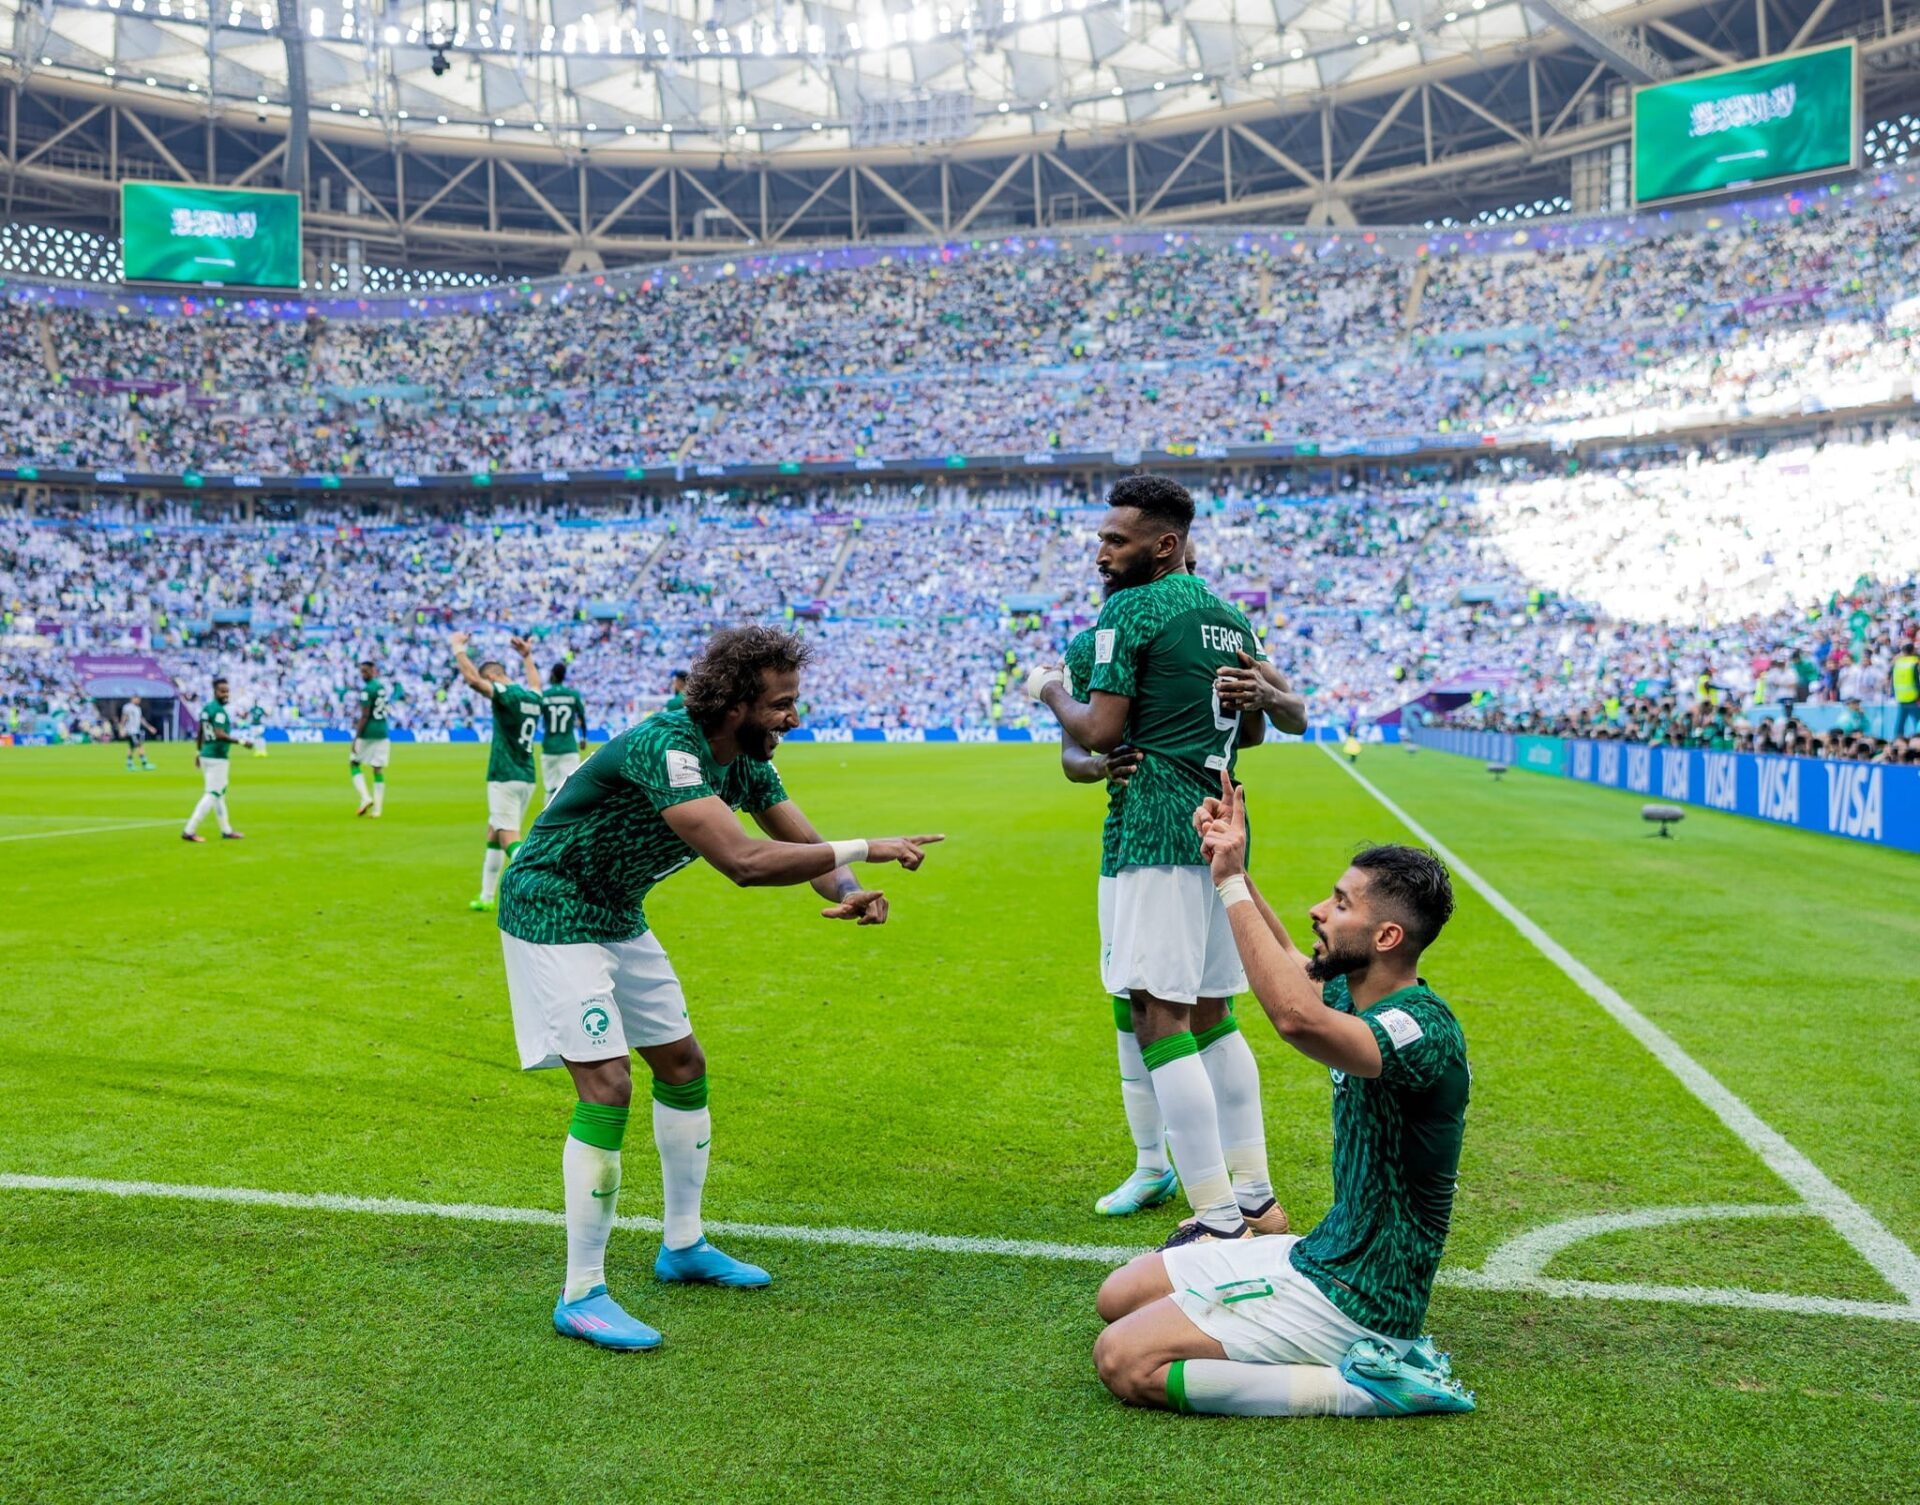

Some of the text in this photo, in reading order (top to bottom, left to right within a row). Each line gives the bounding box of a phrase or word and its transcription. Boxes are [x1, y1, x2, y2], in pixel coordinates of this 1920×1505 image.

[1201, 624, 1243, 652] FERAS
[518, 717, 536, 753] 9
[548, 704, 572, 733] 17
[812, 728, 853, 742] VISA
[883, 728, 925, 742] VISA
[955, 728, 998, 742] VISA
[1028, 728, 1062, 742] VIS
[1204, 675, 1241, 771] 9
[1626, 745, 1650, 793] VISA
[1661, 748, 1689, 800] VISA
[1702, 752, 1737, 811] VISA
[1755, 757, 1799, 823] VISA
[1825, 763, 1882, 840] VISA
